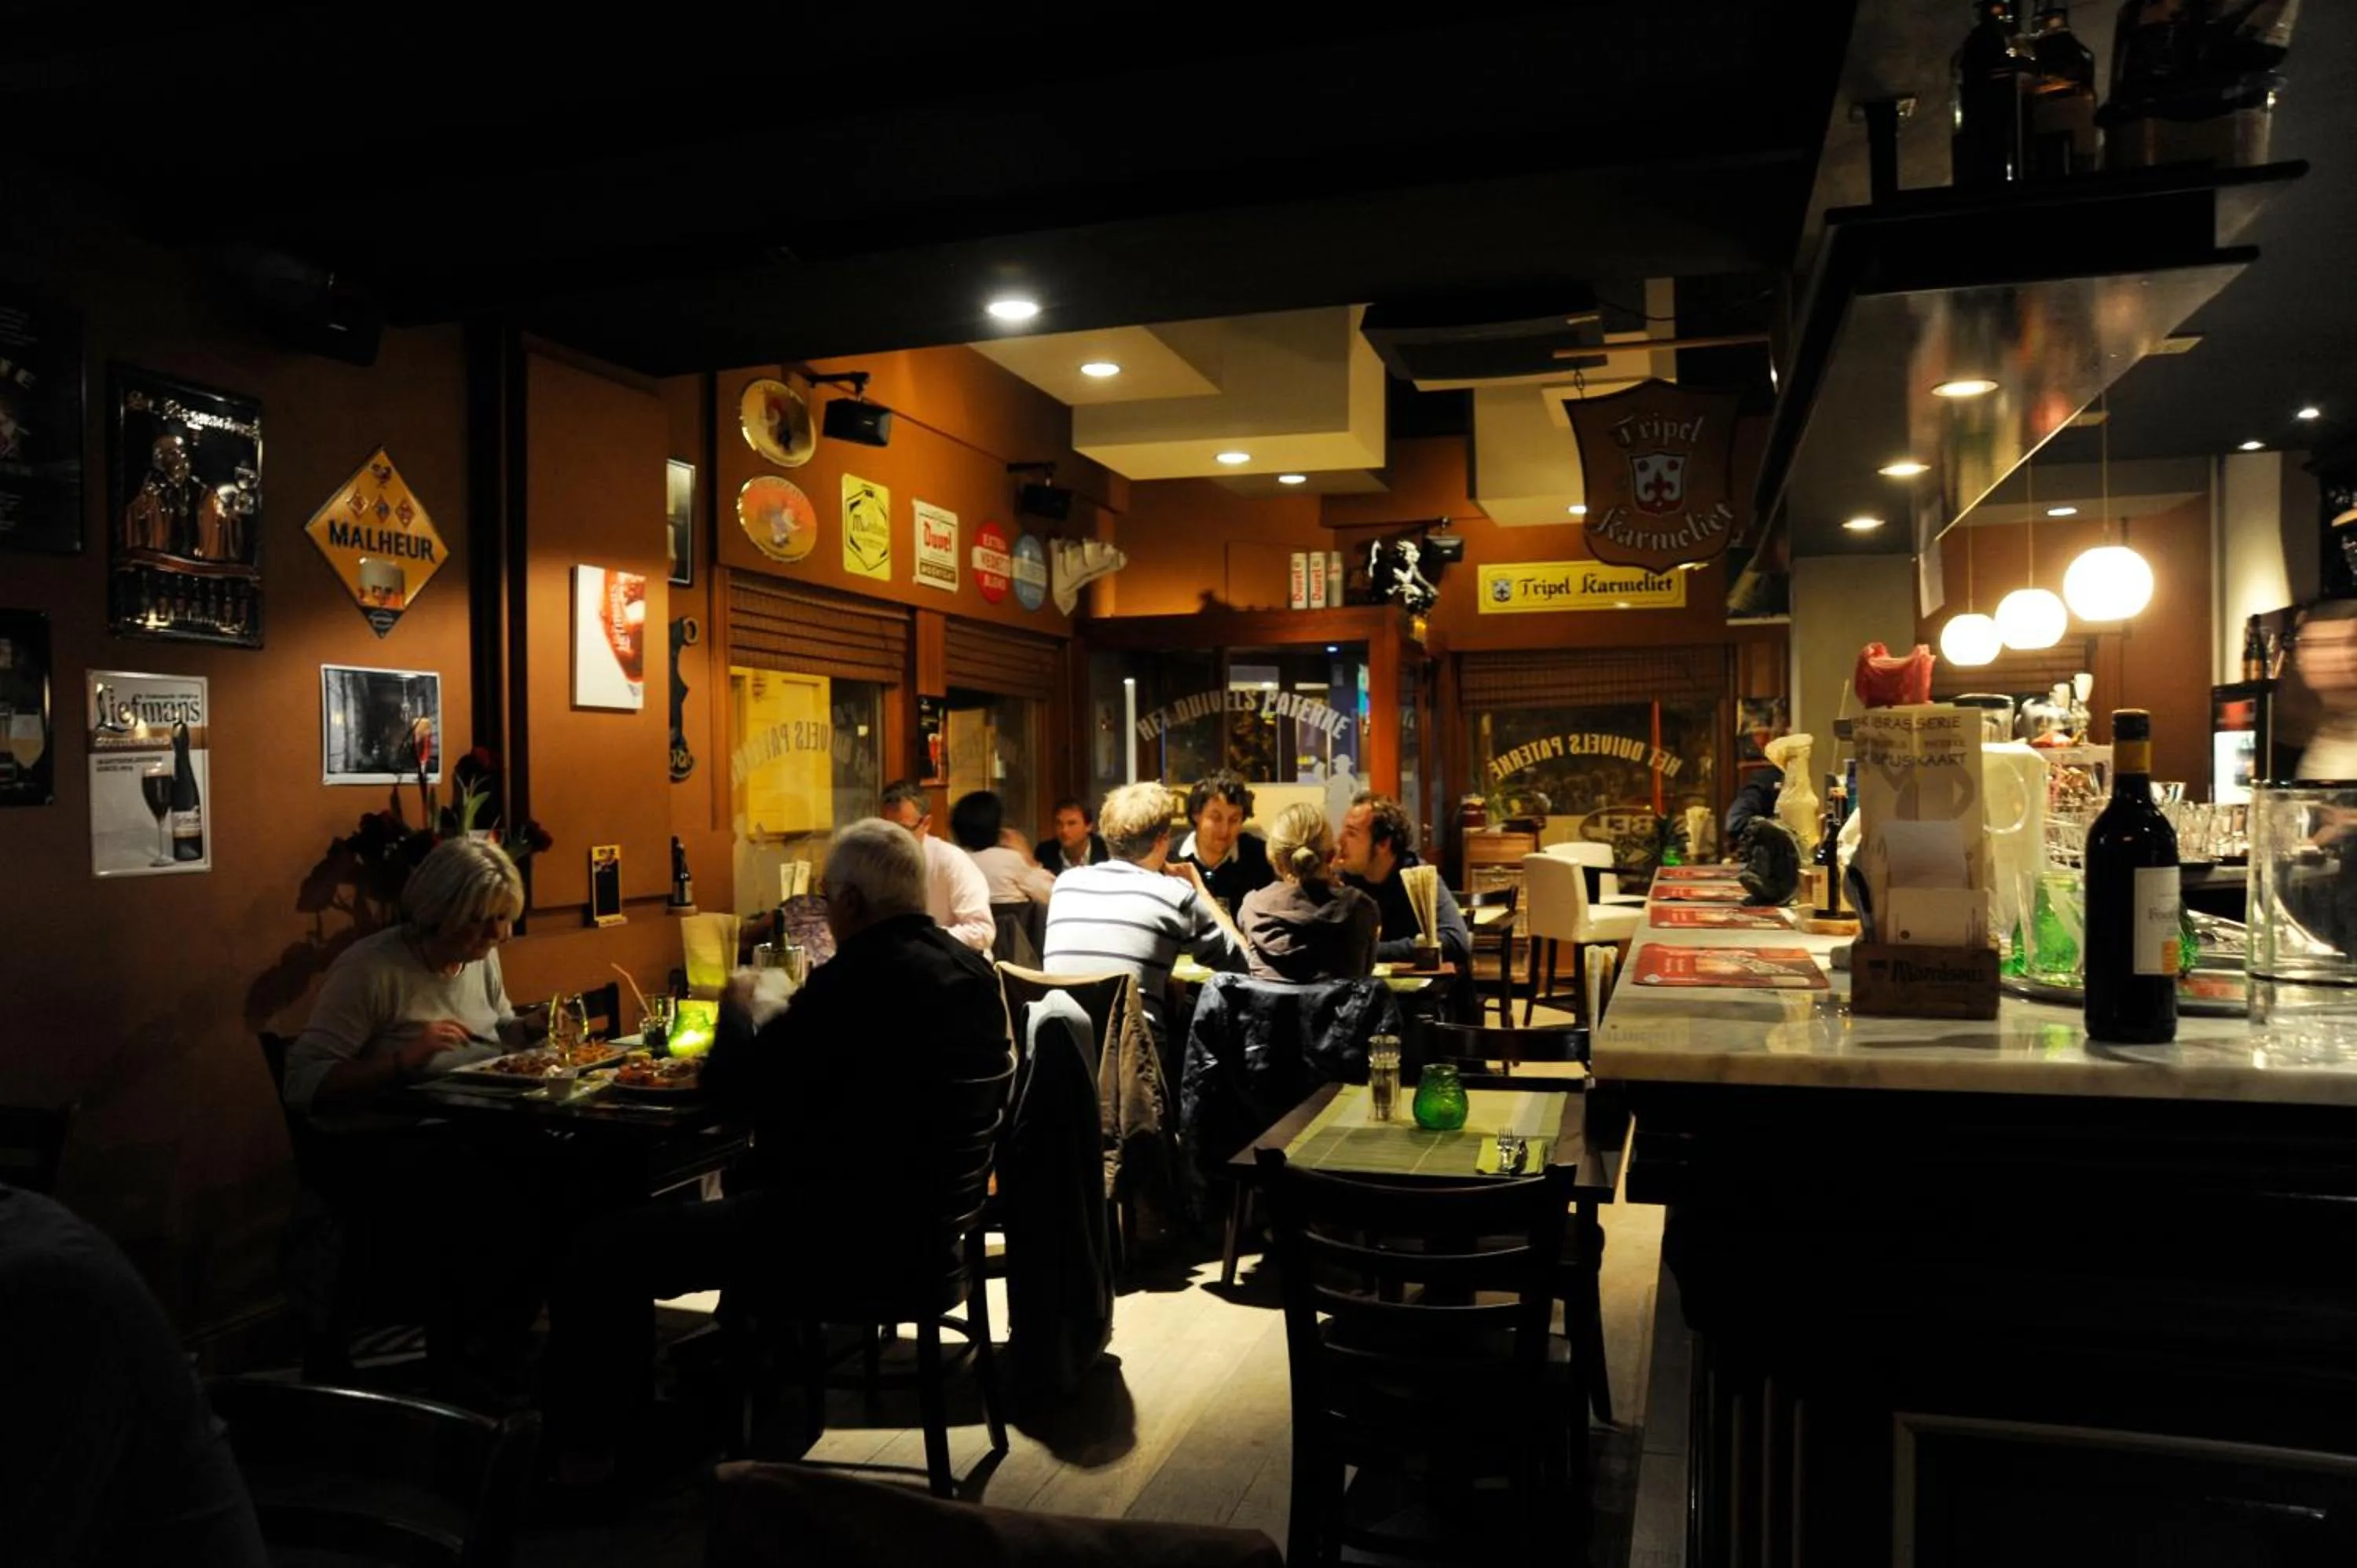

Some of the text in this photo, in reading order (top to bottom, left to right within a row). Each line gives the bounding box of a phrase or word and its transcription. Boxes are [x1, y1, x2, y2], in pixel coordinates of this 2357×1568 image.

[1611, 408, 1706, 448] Tripel
[328, 518, 436, 564] MALHEUR
[923, 521, 952, 553] Duvel
[1589, 500, 1734, 551] Karmeliet
[1518, 572, 1673, 601] Tripel Karmeliet
[96, 683, 201, 733] Liefmans
[1136, 709, 1172, 742] HET
[1173, 690, 1257, 724] DUIVELS
